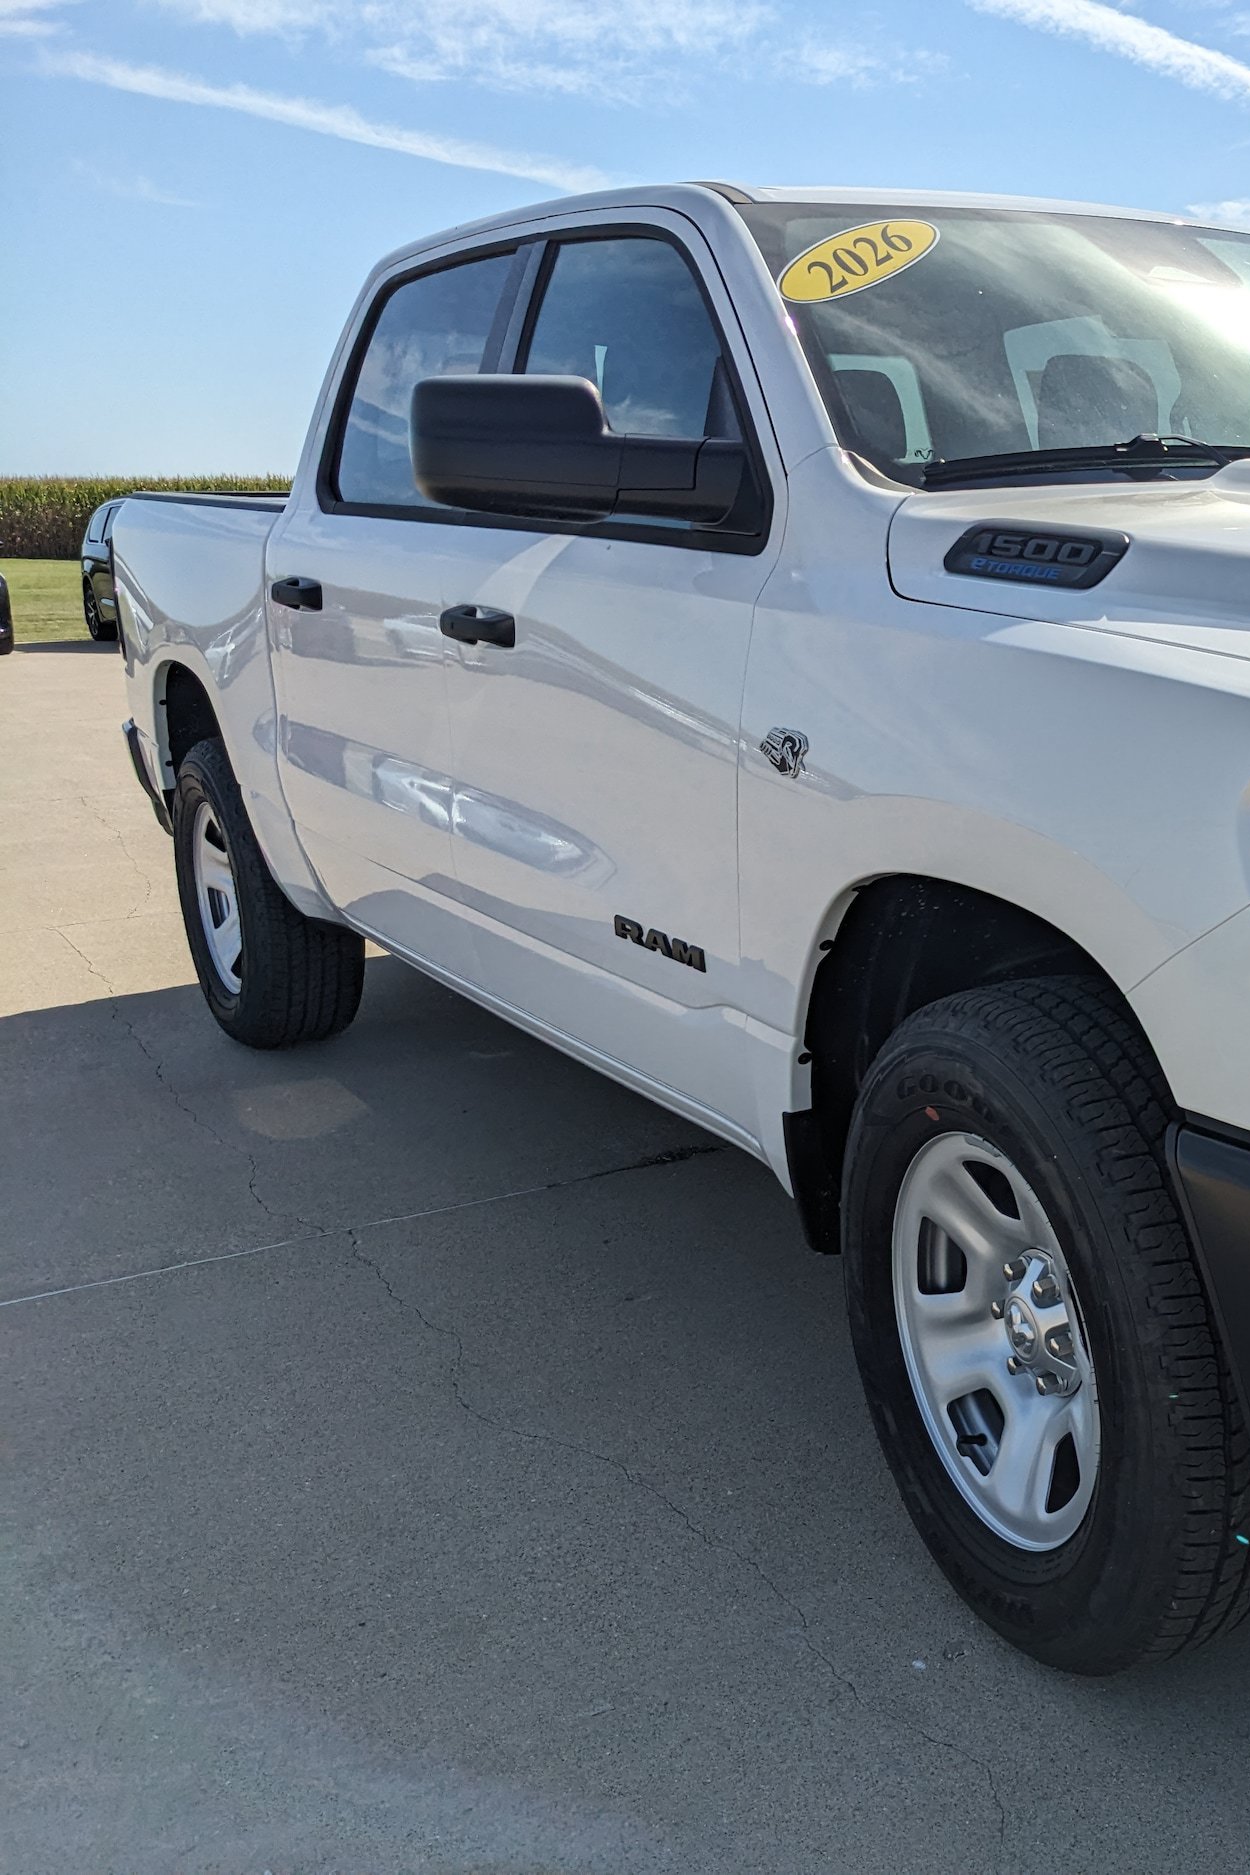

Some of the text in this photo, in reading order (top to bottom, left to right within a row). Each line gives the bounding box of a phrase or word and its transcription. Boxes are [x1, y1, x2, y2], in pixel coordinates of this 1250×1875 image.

[807, 224, 913, 294] 2026
[972, 533, 1096, 564] 1500
[614, 914, 707, 973] RAM
